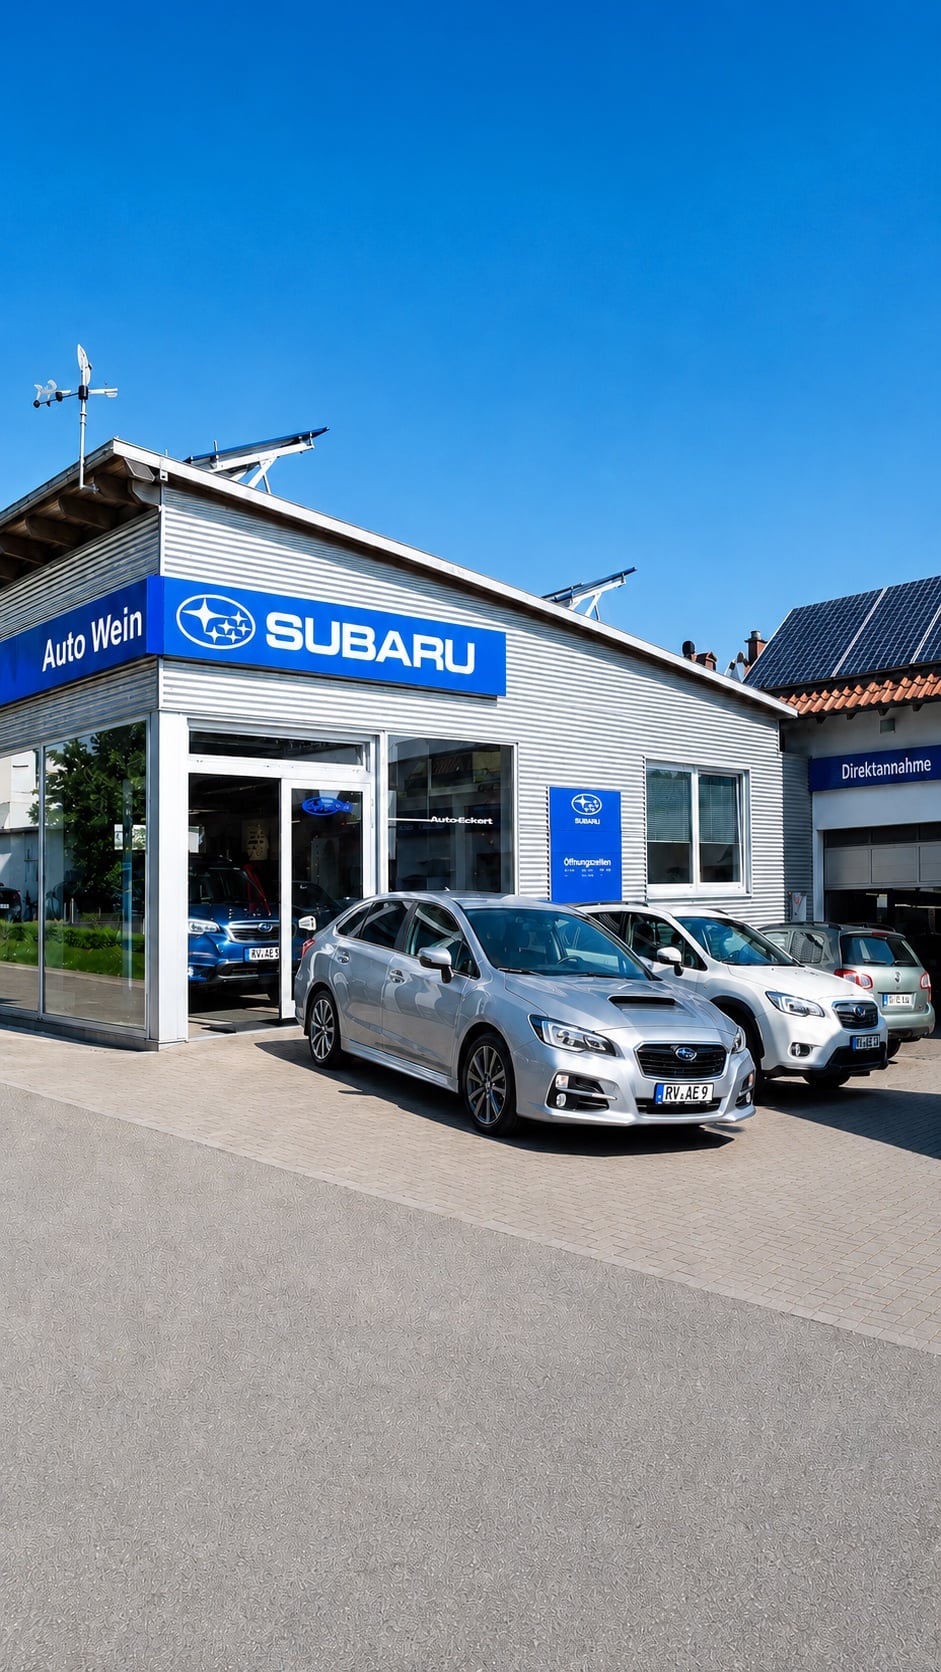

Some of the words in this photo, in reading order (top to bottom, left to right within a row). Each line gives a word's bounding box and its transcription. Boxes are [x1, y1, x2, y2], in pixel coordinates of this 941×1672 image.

[42, 631, 86, 672] Auto
[91, 606, 143, 653] Wein
[266, 611, 475, 674] SUBARU
[842, 757, 931, 779] Direktannahme
[574, 817, 601, 825] SUBARU
[665, 1086, 680, 1100] RV
[685, 1086, 700, 1100] AE
[701, 1085, 709, 1100] 9
